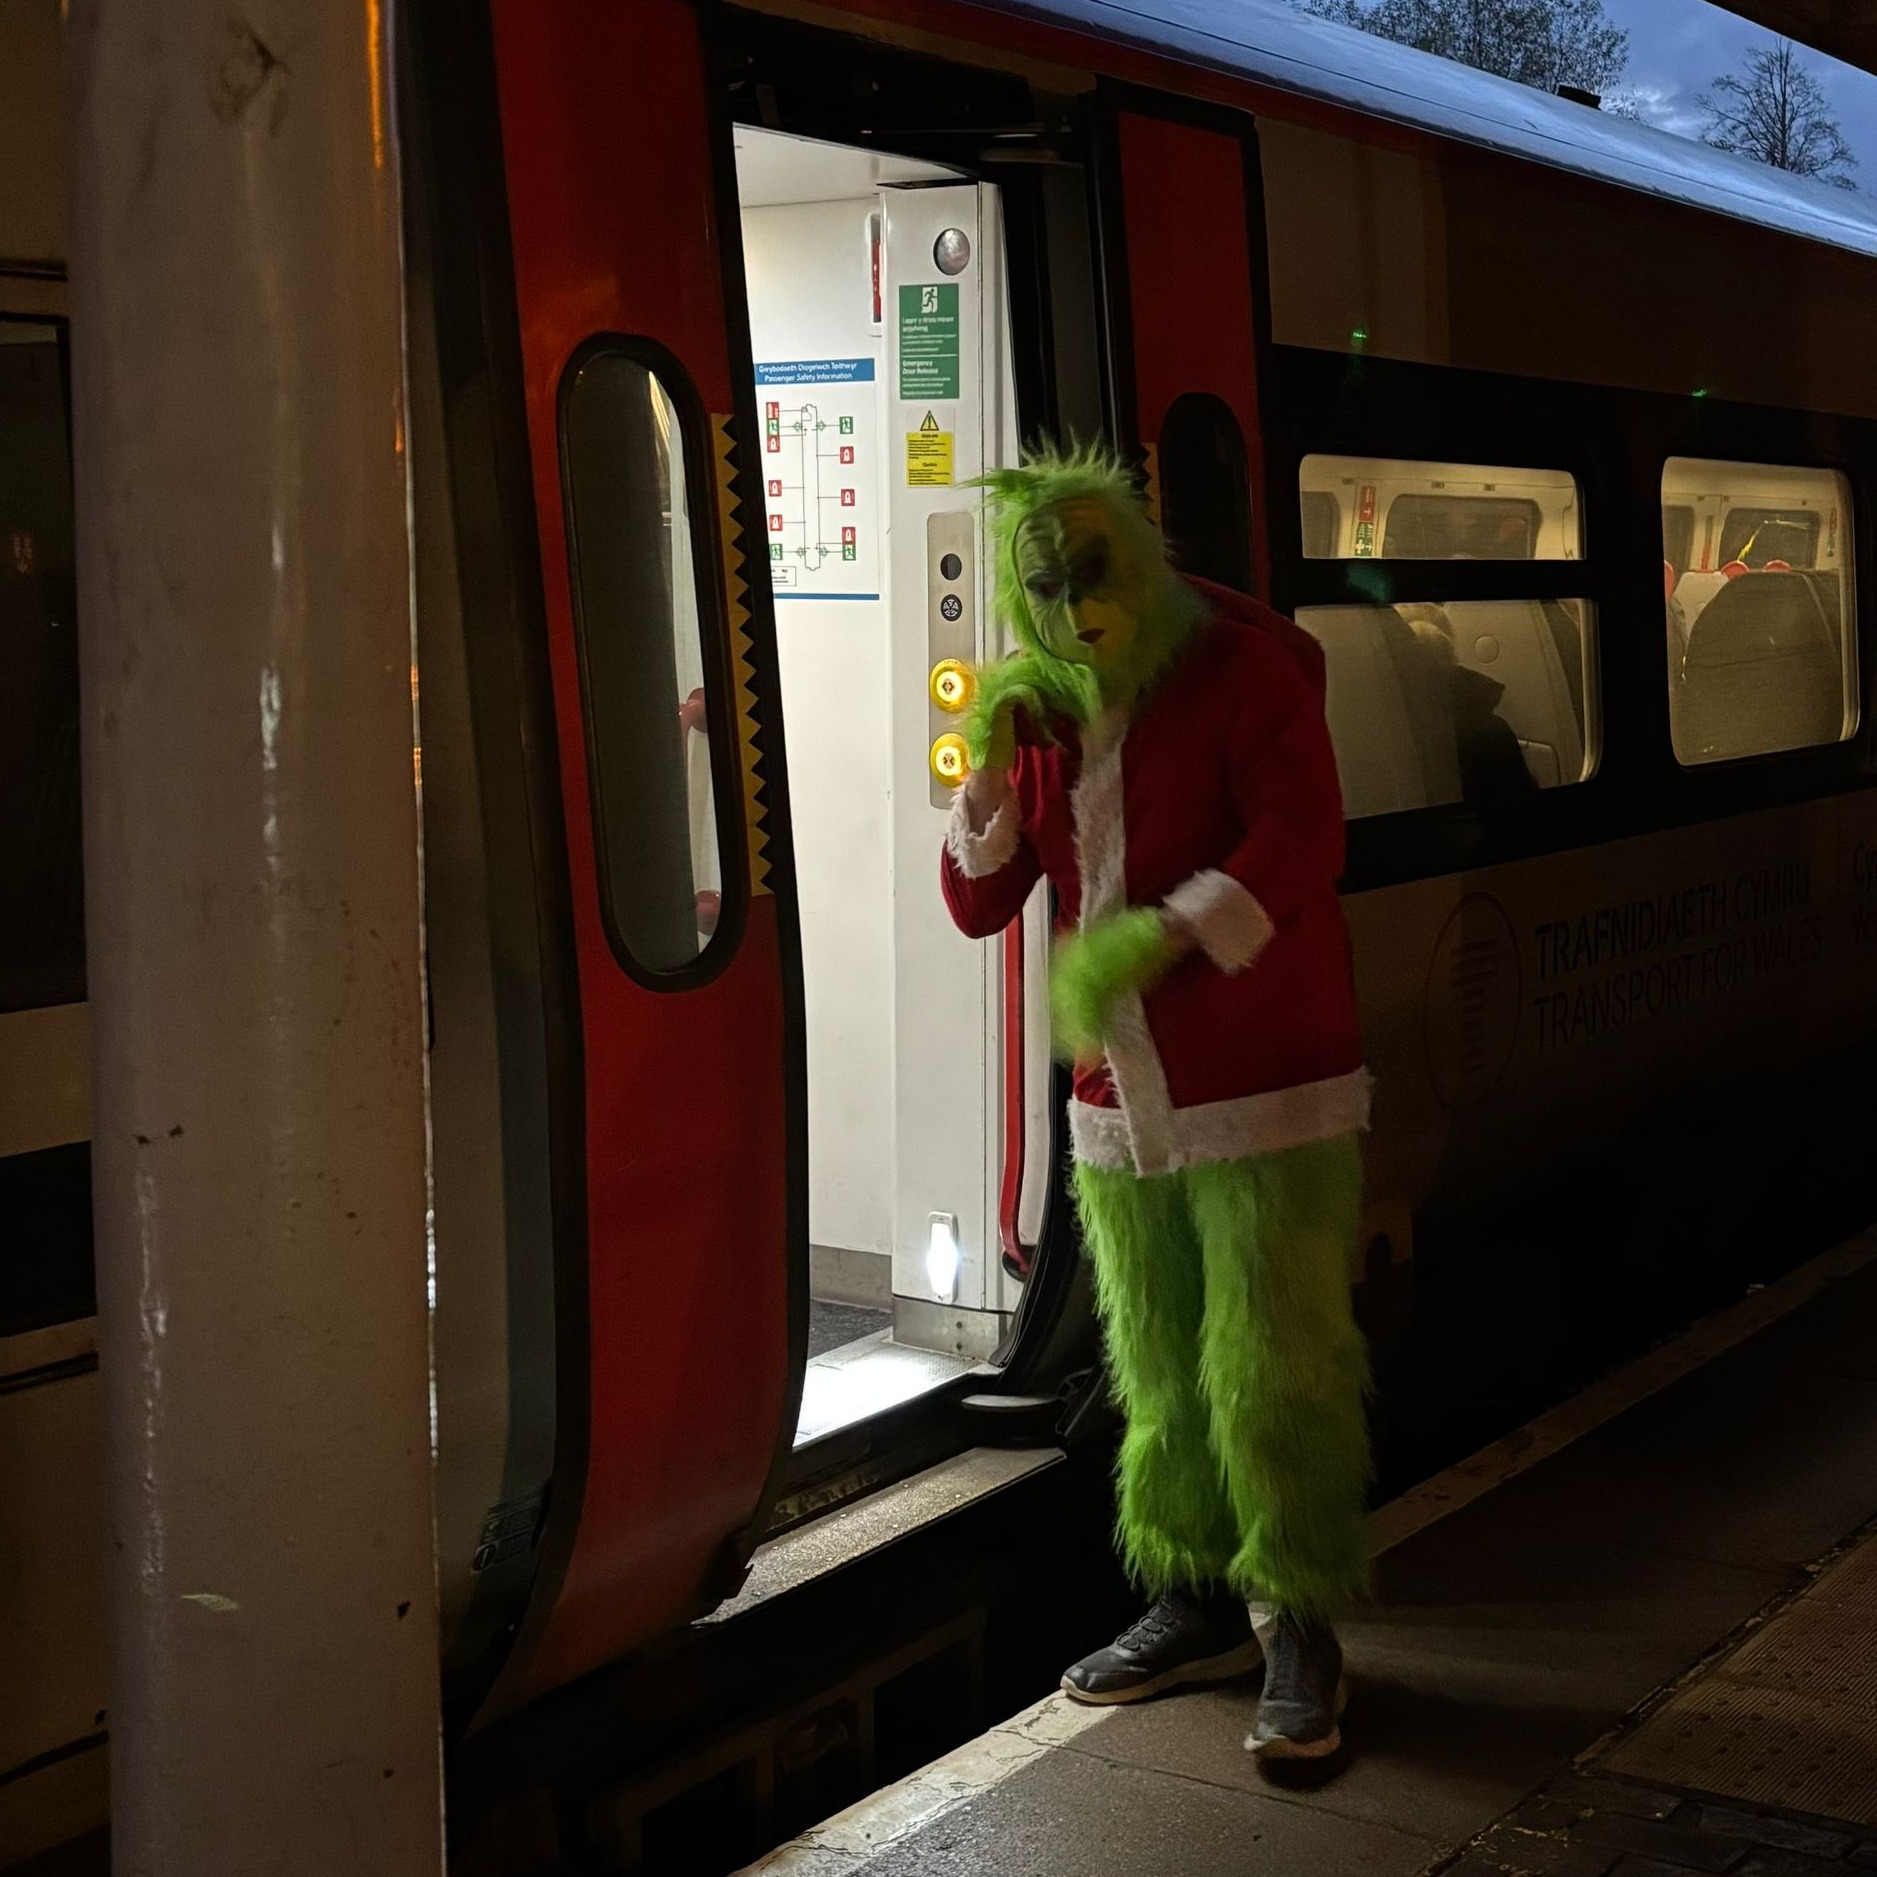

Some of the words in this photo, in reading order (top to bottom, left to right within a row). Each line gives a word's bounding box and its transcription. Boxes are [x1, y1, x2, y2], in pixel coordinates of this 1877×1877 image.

[764, 375, 795, 384] Passenger
[796, 373, 815, 382] Safety
[816, 371, 853, 380] Information
[1534, 879, 1728, 980] TRAFNIDIAETH
[1734, 857, 1810, 923] CYMRU
[1534, 954, 1698, 1054] TRANSPORT
[1701, 937, 1746, 996] FOR
[1753, 914, 1822, 976] WALES
